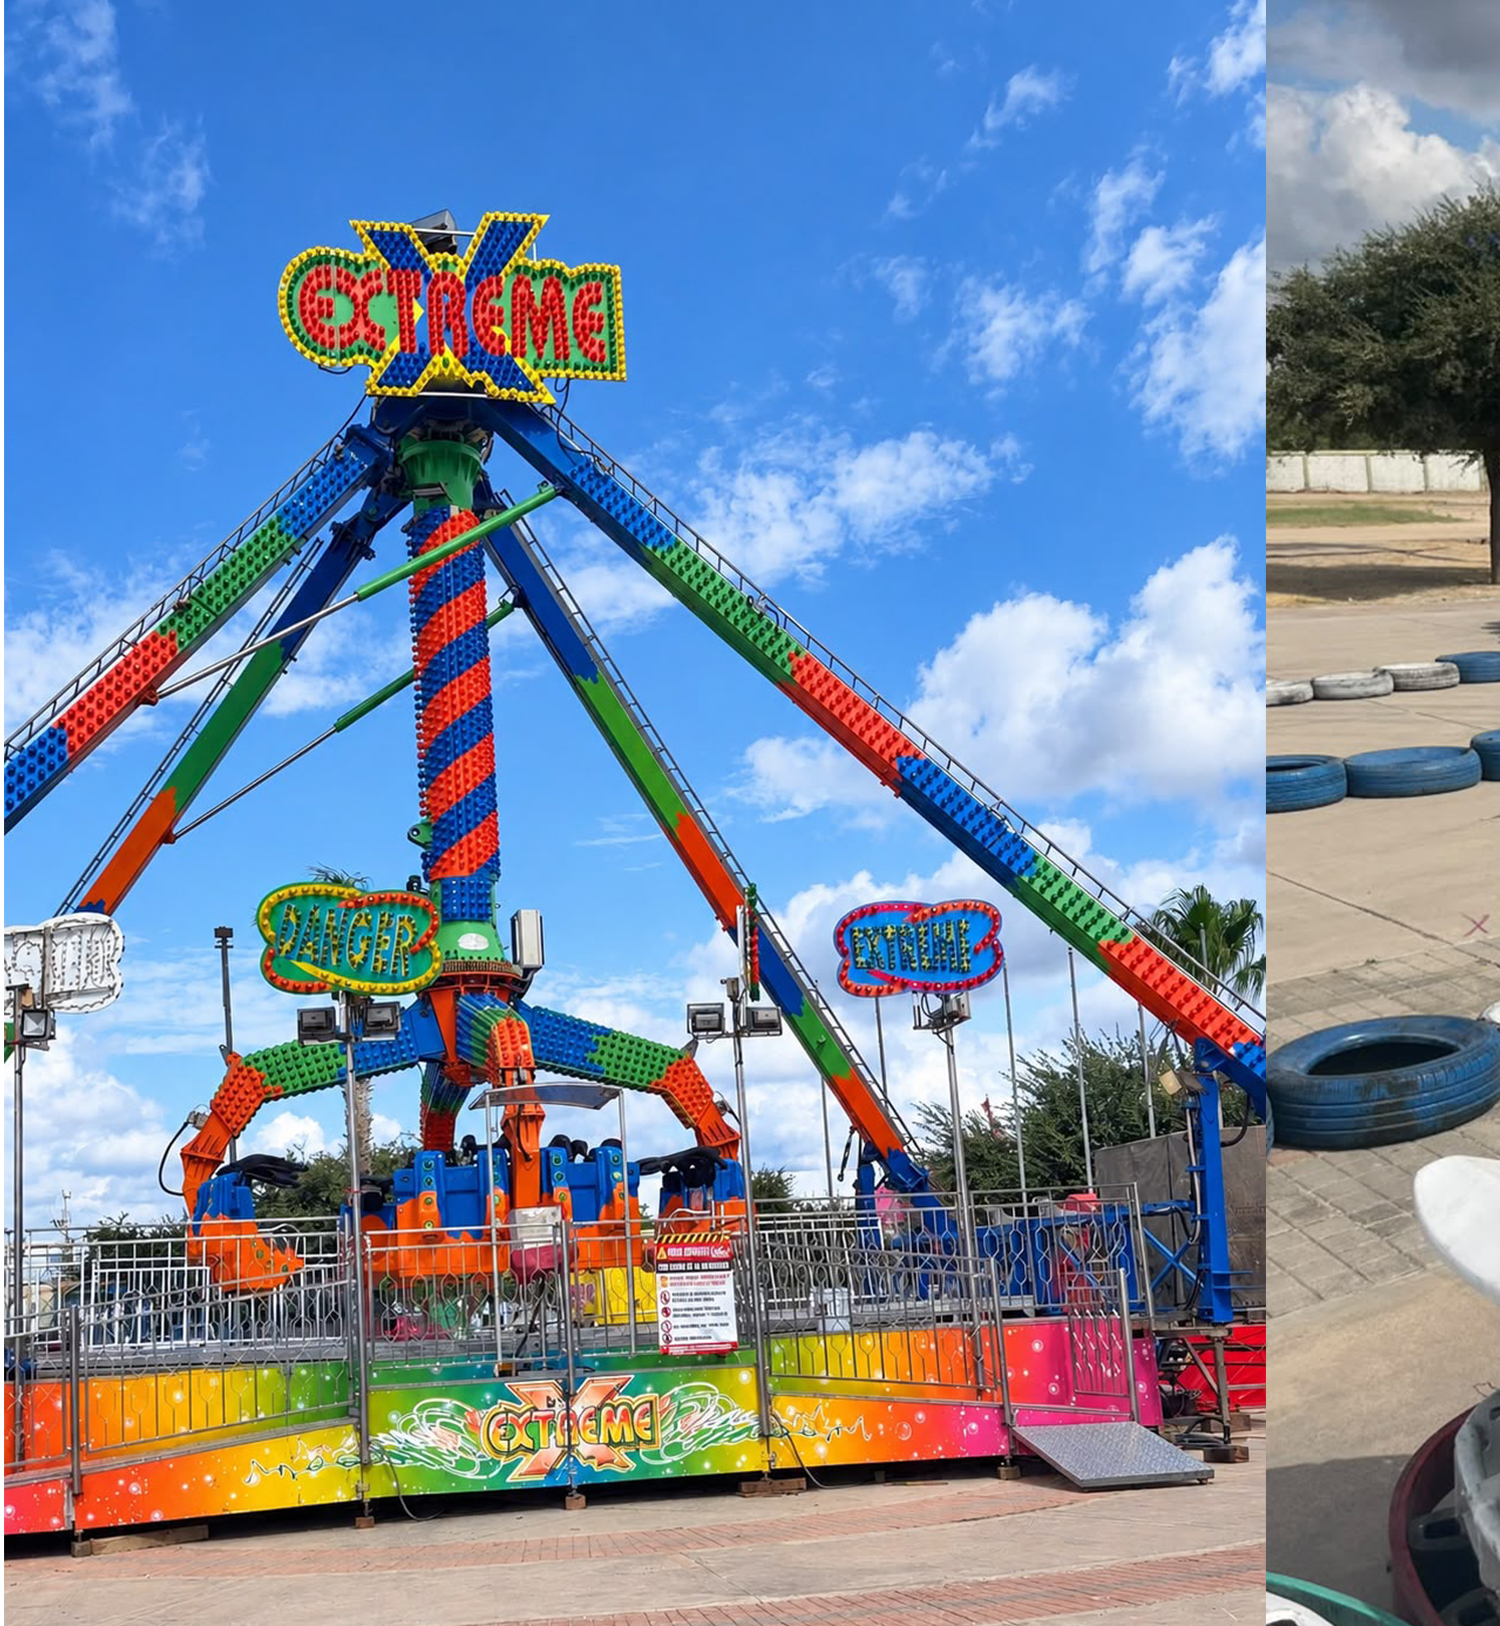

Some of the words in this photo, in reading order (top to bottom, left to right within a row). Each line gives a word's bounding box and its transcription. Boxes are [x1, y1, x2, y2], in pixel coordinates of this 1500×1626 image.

[298, 264, 607, 363] EXTREME
[276, 904, 417, 977] DANGER
[851, 917, 971, 973] EXTREME
[489, 1403, 652, 1452] EXTREME
